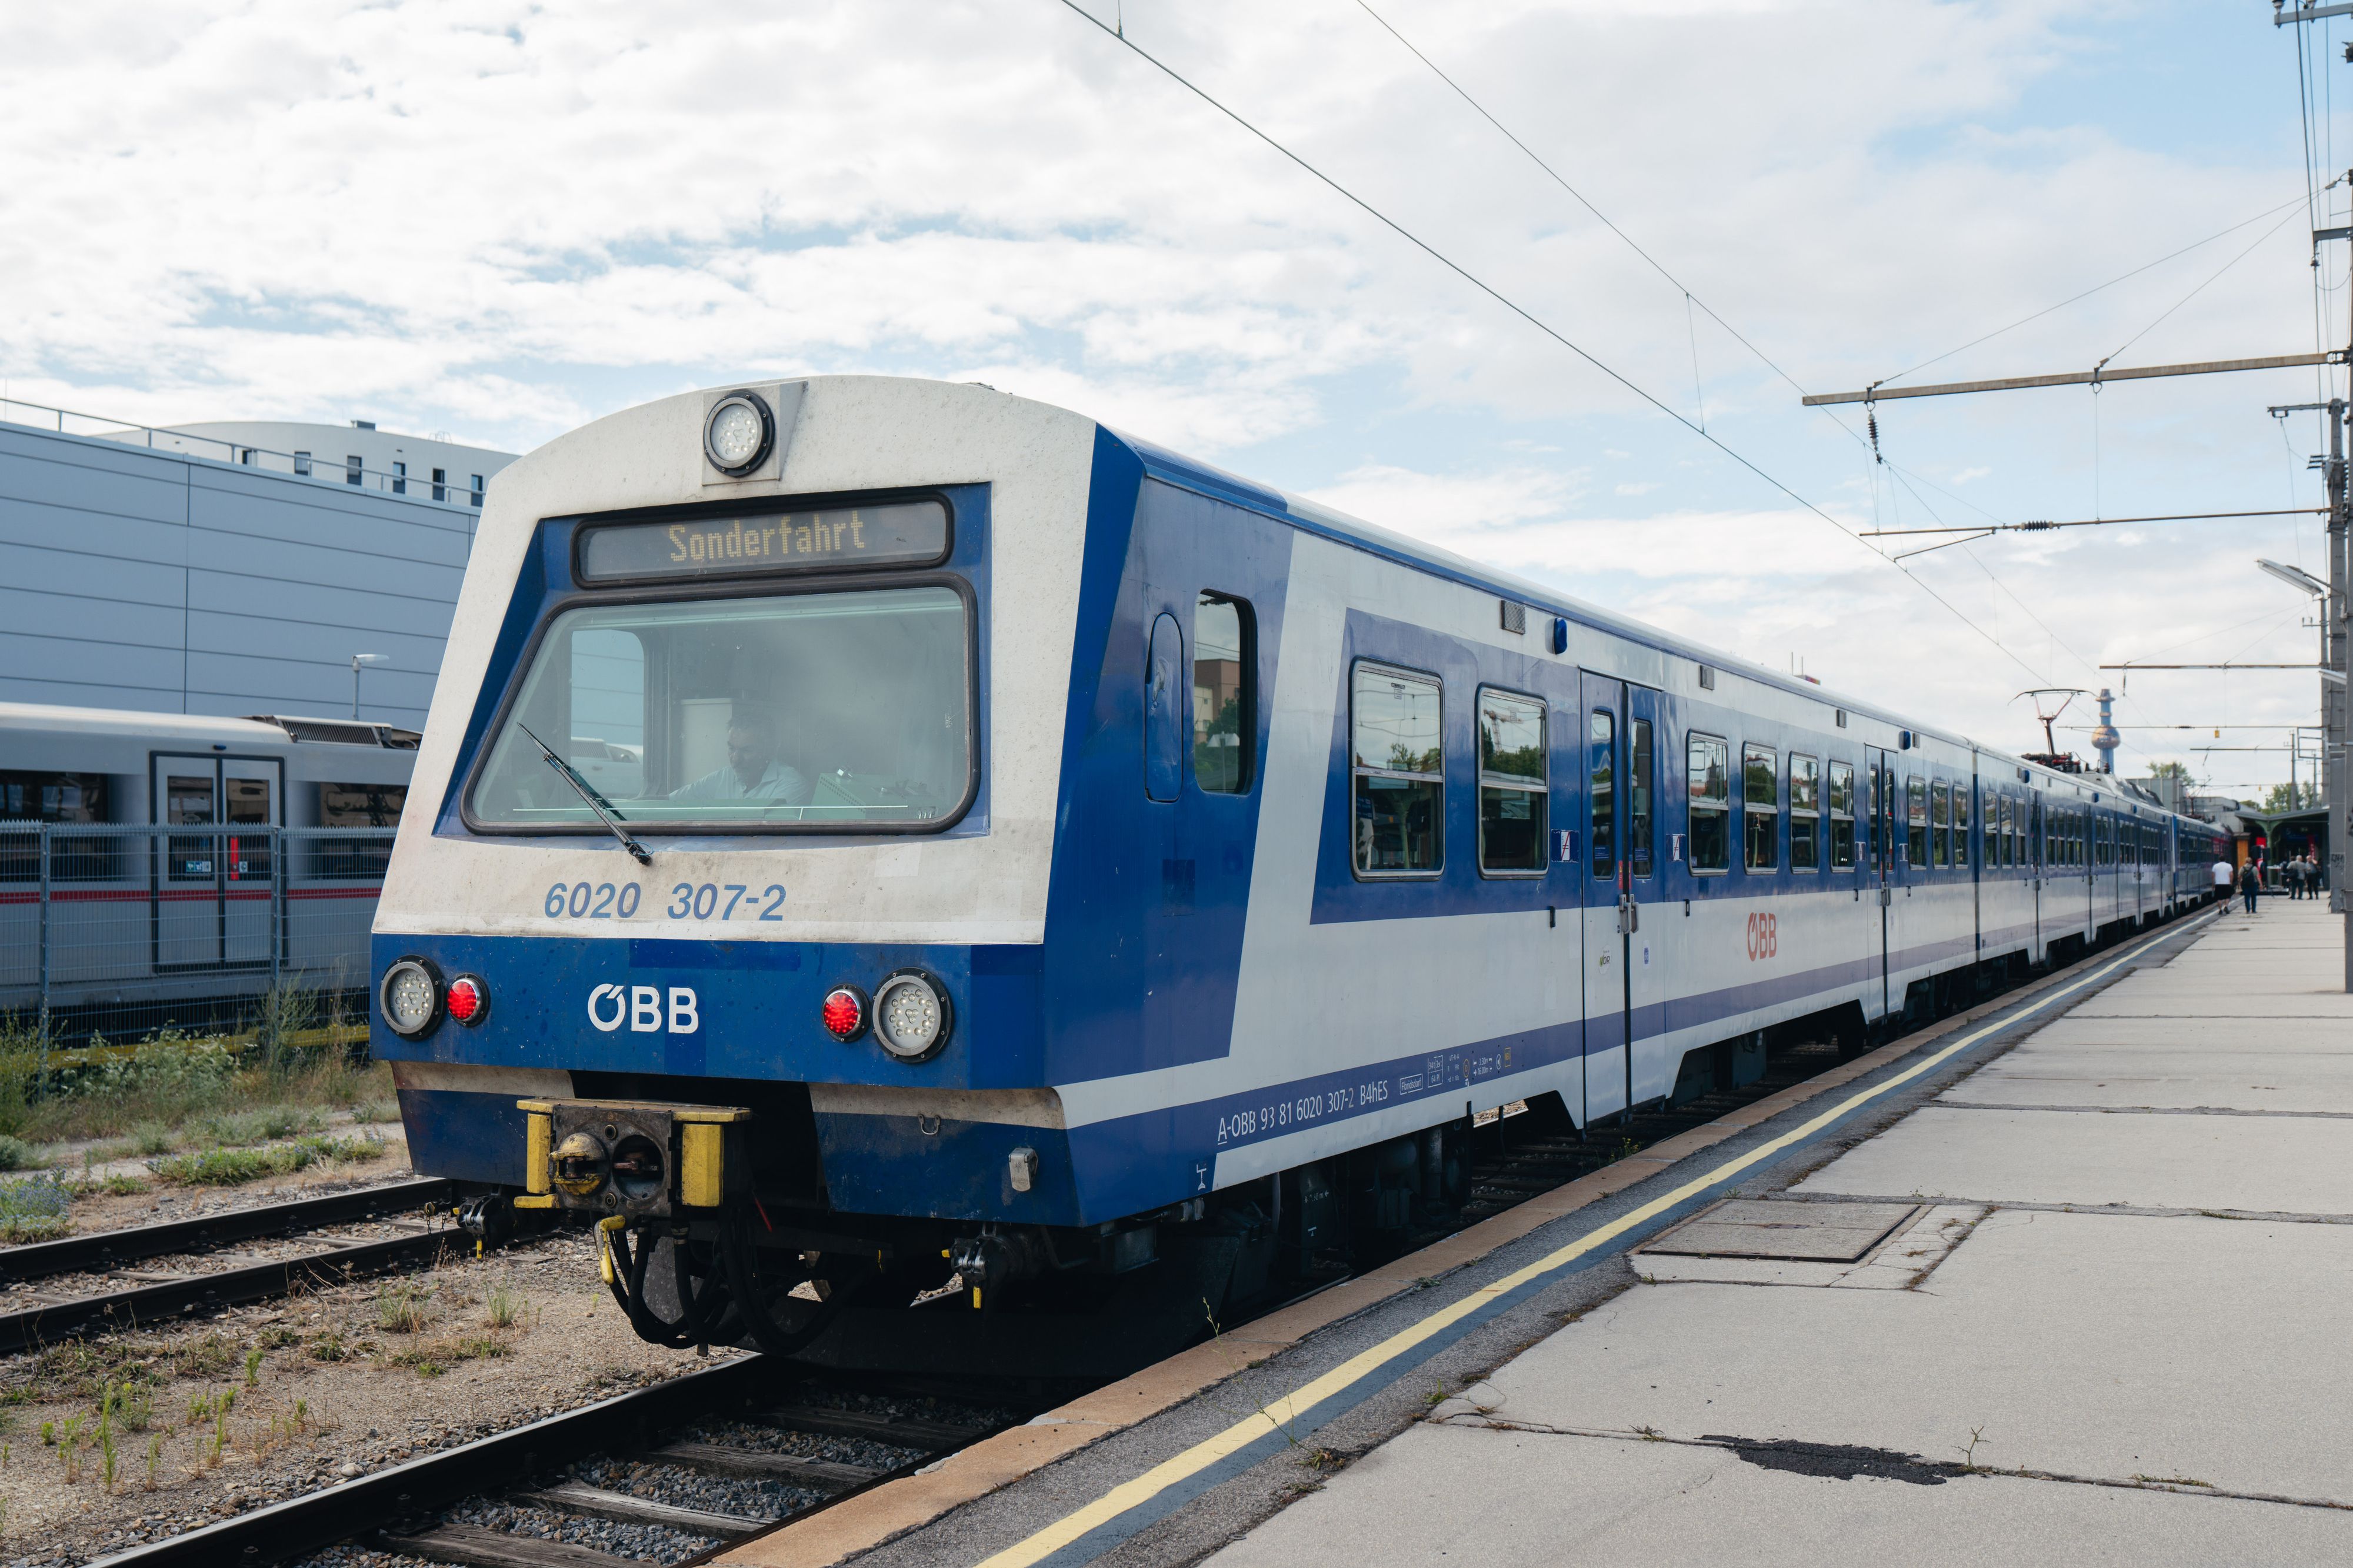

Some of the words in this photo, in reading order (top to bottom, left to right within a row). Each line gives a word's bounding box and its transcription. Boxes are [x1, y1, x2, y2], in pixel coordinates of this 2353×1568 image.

[669, 510, 866, 562] Sonderfahrt
[544, 882, 641, 919] 6020
[667, 883, 787, 921] 307-2
[1747, 912, 1777, 962] ÖBB
[587, 983, 699, 1035] ÖBB
[1261, 1106, 1275, 1130] 93
[1279, 1101, 1292, 1126] 81
[1297, 1095, 1322, 1121] 6020
[1328, 1087, 1354, 1113] 307-2
[1360, 1080, 1388, 1105] B4hES
[1401, 1077, 1422, 1092] Floridsdorf
